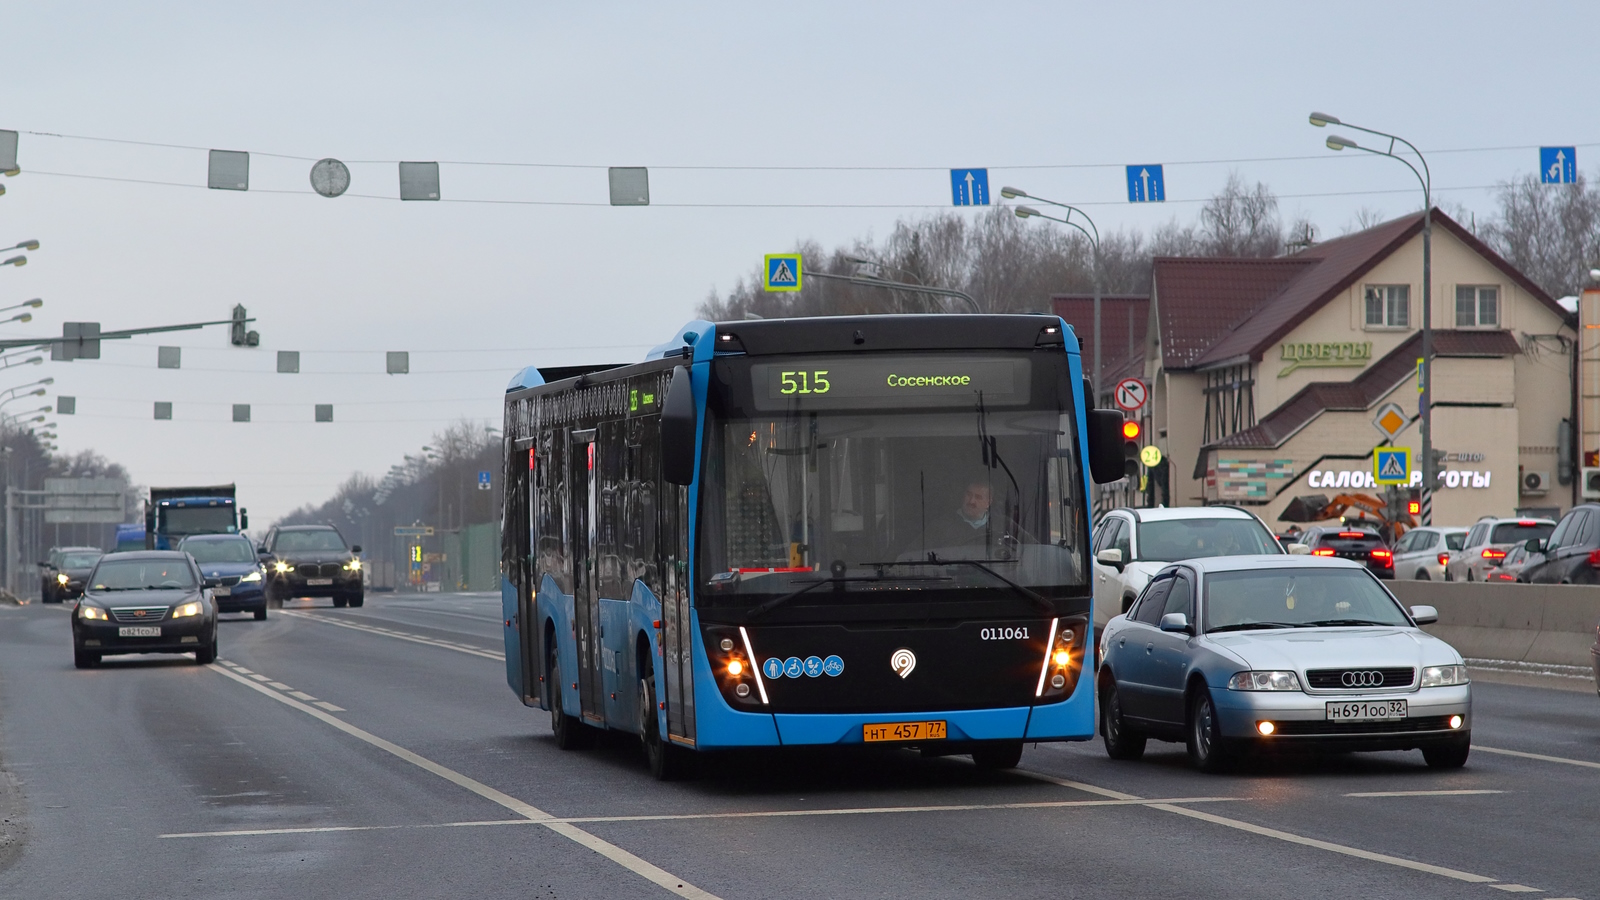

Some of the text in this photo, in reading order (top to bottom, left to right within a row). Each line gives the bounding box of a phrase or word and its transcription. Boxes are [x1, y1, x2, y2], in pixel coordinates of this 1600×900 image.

[1281, 342, 1373, 361] ЦВЕТЫ
[780, 371, 831, 394] 515
[887, 374, 970, 387] Сосенское
[1144, 450, 1158, 462] 24
[980, 627, 1030, 640] 011061
[1389, 702, 1402, 713] 32
[893, 724, 920, 739] 457
[927, 722, 942, 733] 77
